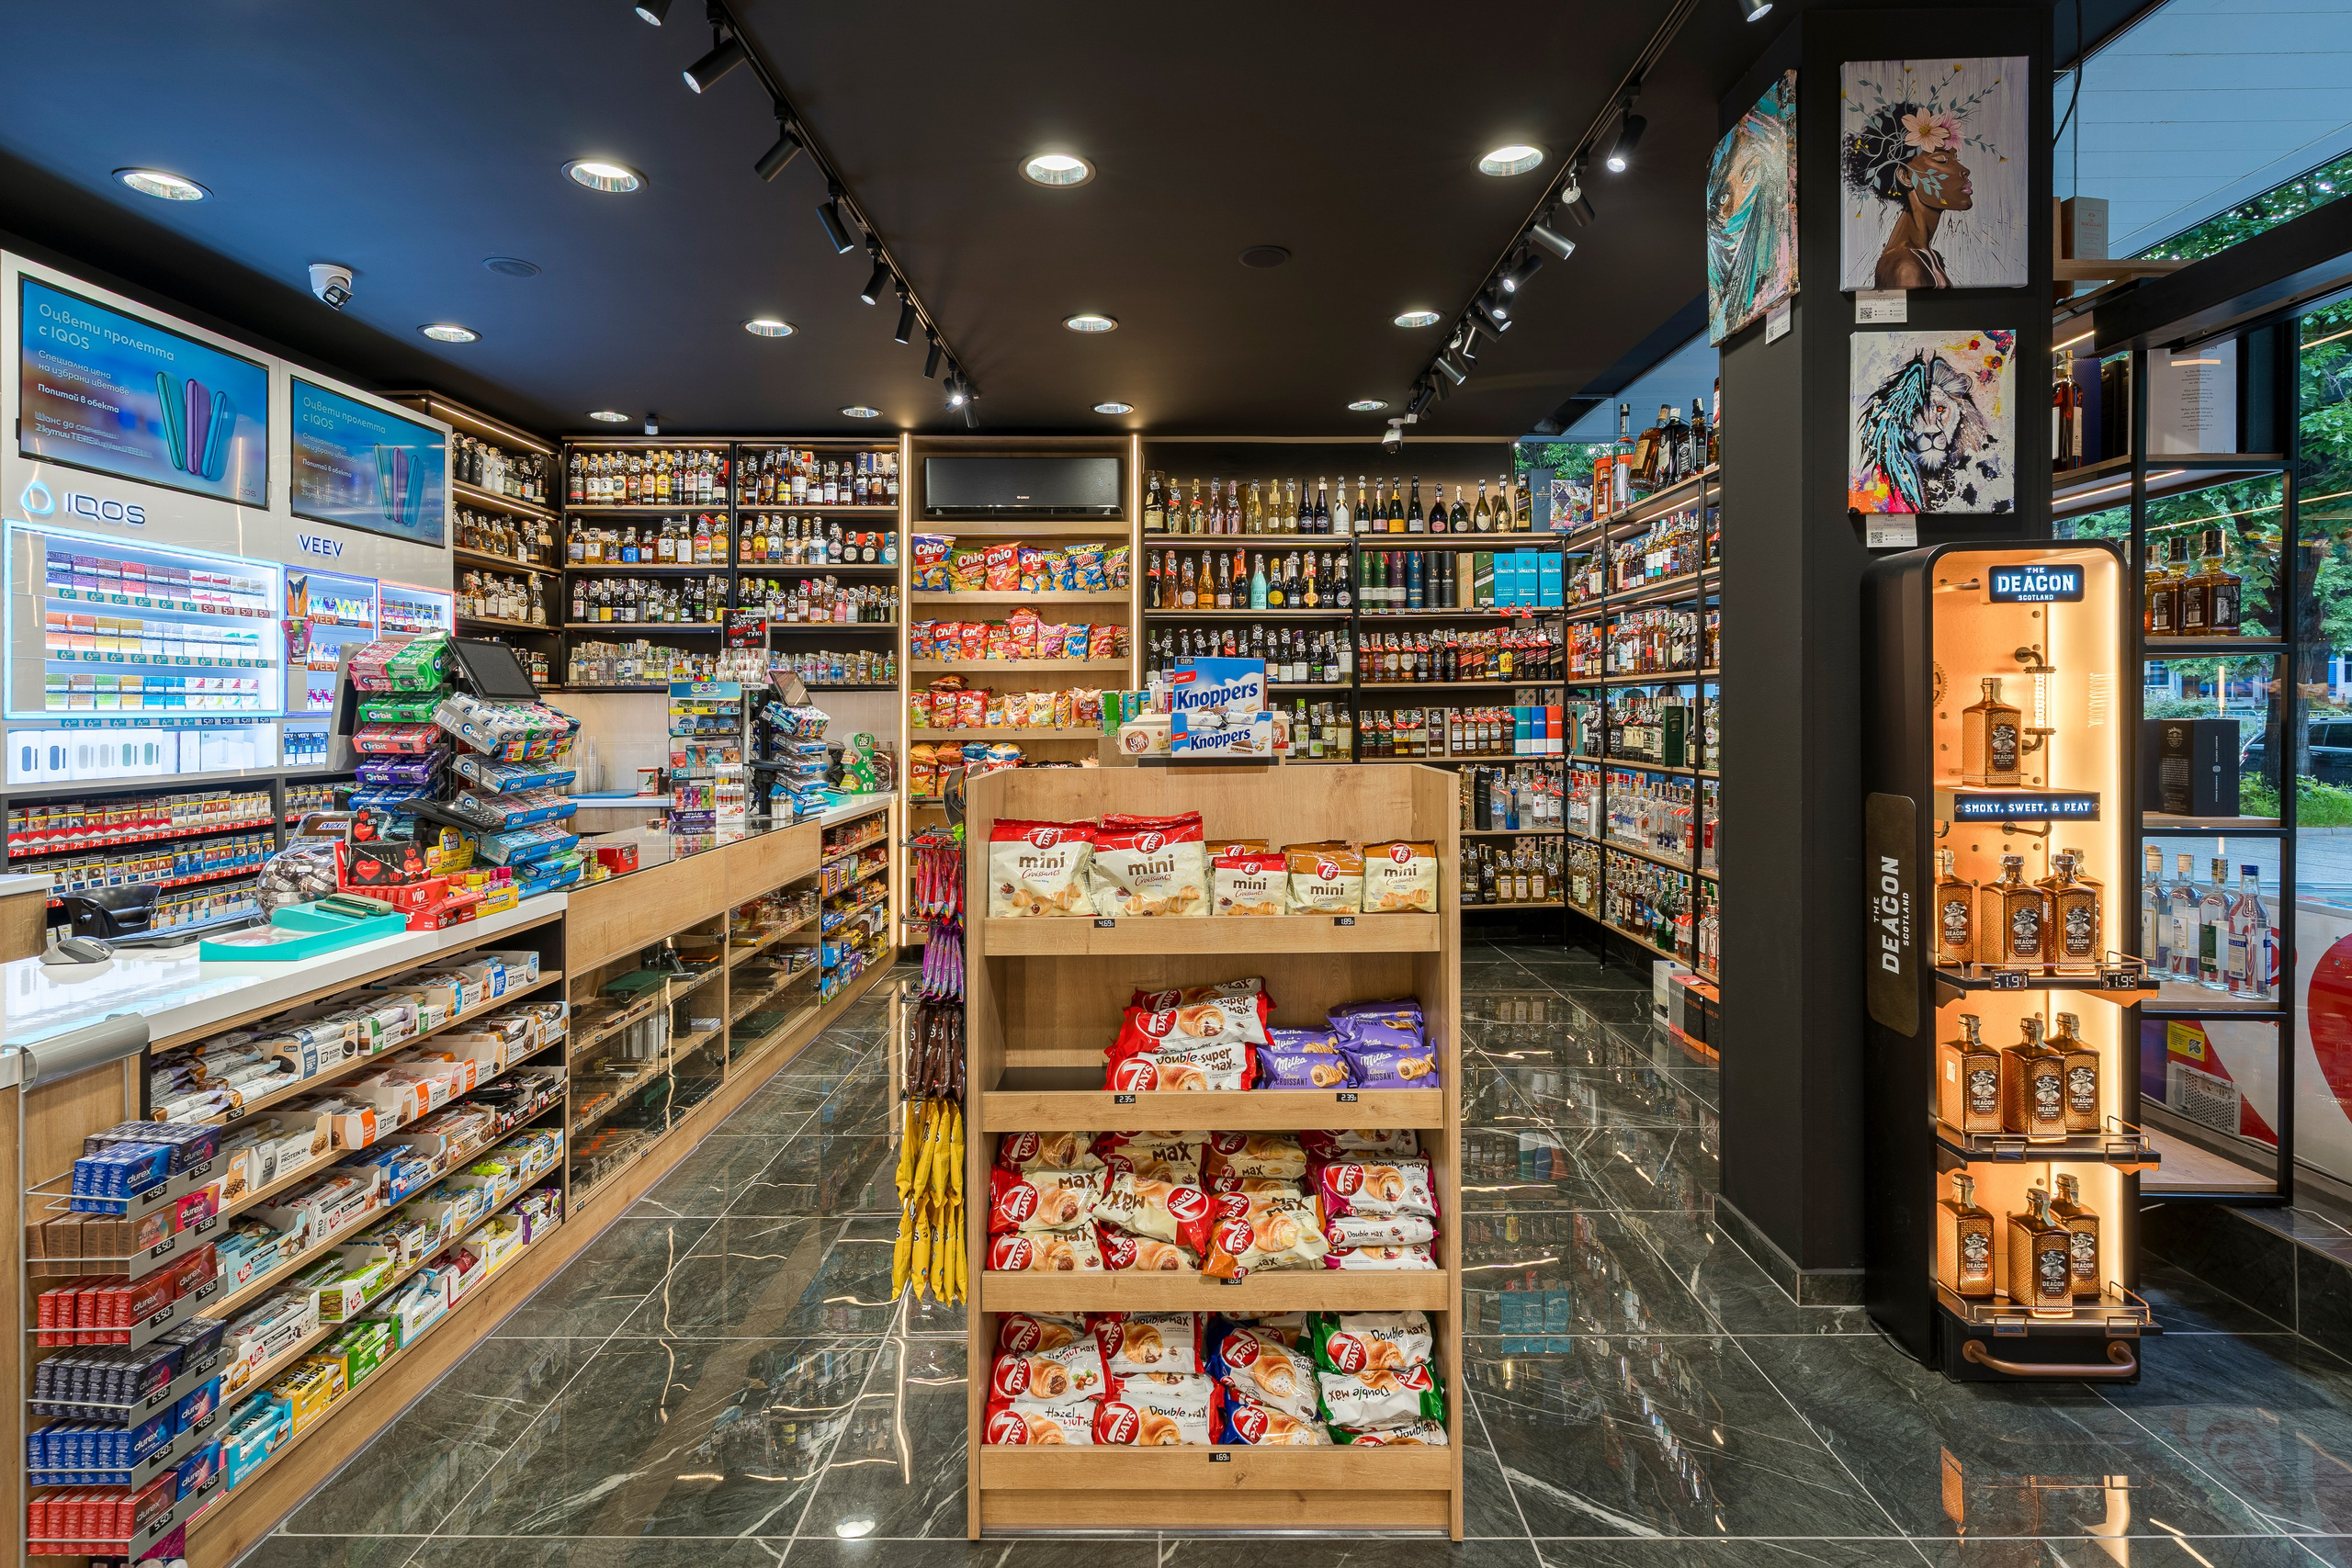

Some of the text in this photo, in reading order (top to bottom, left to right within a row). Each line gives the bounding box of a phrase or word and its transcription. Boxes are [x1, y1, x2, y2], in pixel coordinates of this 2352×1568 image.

[39, 303, 175, 361] Оцвети пролетта
[51, 326, 90, 349] IQOS
[39, 350, 110, 379] Специална цена
[39, 365, 130, 396] на избрани цветове
[38, 383, 78, 404] Попитай
[87, 399, 119, 413] обекта
[303, 397, 385, 434] Оцвети пролетта
[311, 414, 334, 430] IQOS
[67, 492, 145, 525] IQOS
[299, 534, 343, 557] VEEV
[915, 543, 945, 556] Chio
[958, 552, 985, 568] Chio
[987, 548, 1012, 566] Chio
[1997, 575, 2074, 592] DEACON
[313, 615, 338, 624] VEEV
[314, 662, 337, 671] VEEV
[1177, 682, 1258, 710] Knoppers
[368, 711, 393, 720] Orbit
[462, 723, 484, 741] Orbit
[1191, 728, 1250, 750] Knoppers
[363, 742, 387, 750] Orbit
[1130, 735, 1144, 746] LOVE
[1131, 739, 1148, 752] NUTTY
[365, 773, 390, 782] Orbit
[358, 810, 369, 820] vip
[1964, 803, 2089, 813] SMOKY, SWEET, & PEAT
[319, 822, 348, 830] SNICKER
[404, 848, 417, 858] vip
[1019, 852, 1066, 868] mini
[442, 860, 458, 868] SHOT
[1127, 854, 1174, 876] mini
[1384, 863, 1417, 878] mini
[389, 872, 403, 882] vip
[1022, 869, 1060, 879] Croissants
[1134, 873, 1172, 886] Croissants
[1385, 876, 1416, 886] Croissants
[1233, 877, 1267, 890] mini
[1310, 883, 1344, 896] mini
[412, 888, 425, 901] vip
[1235, 889, 1263, 897] Croissants
[1312, 895, 1341, 904] Croissants
[1882, 856, 1900, 975] DEACON
[1274, 1055, 1307, 1072] Milka
[1361, 1050, 1393, 1067] Milka
[1275, 1077, 1307, 1087] CROISSANT
[184, 1146, 208, 1163] durex
[281, 1151, 300, 1164] PROTEIN
[127, 1167, 153, 1184] durex
[194, 1163, 208, 1177] 6.50
[1345, 1164, 1360, 1191] DAYS
[147, 1186, 164, 1201] 4.50
[180, 1202, 206, 1219] durex
[1018, 1188, 1035, 1217] DAYS
[198, 1216, 213, 1232] 5.80
[138, 1224, 163, 1241] durex
[155, 1240, 171, 1255] 6.50
[1011, 1240, 1030, 1269] DAYS
[179, 1268, 202, 1287] durex
[200, 1282, 215, 1298] 5.50
[133, 1293, 159, 1312] durex
[154, 1308, 170, 1324] 5.50
[1017, 1322, 1038, 1352] DAYS
[1371, 1325, 1404, 1341] Double
[360, 1335, 374, 1348] OSHEE
[187, 1346, 209, 1362] durex
[1233, 1340, 1258, 1363] DAYS
[1345, 1340, 1361, 1370] DAYS
[200, 1357, 215, 1371] 5.80
[139, 1373, 163, 1391] durex
[277, 1362, 312, 1387] OSHEE
[292, 1365, 326, 1390] OSHEE
[152, 1387, 167, 1404] 6.50
[181, 1400, 204, 1418] durex
[1046, 1406, 1075, 1418] Hazel
[1149, 1404, 1186, 1420] Double
[198, 1414, 213, 1427] 4.50
[231, 1410, 270, 1435] OSHEE
[1115, 1411, 1136, 1443] DAYS
[134, 1433, 159, 1451] durex
[154, 1443, 170, 1459] 4.50
[181, 1469, 204, 1487] durex
[201, 1475, 218, 1490] 4.50
[136, 1500, 161, 1521] durex
[154, 1514, 170, 1531] 5.50
